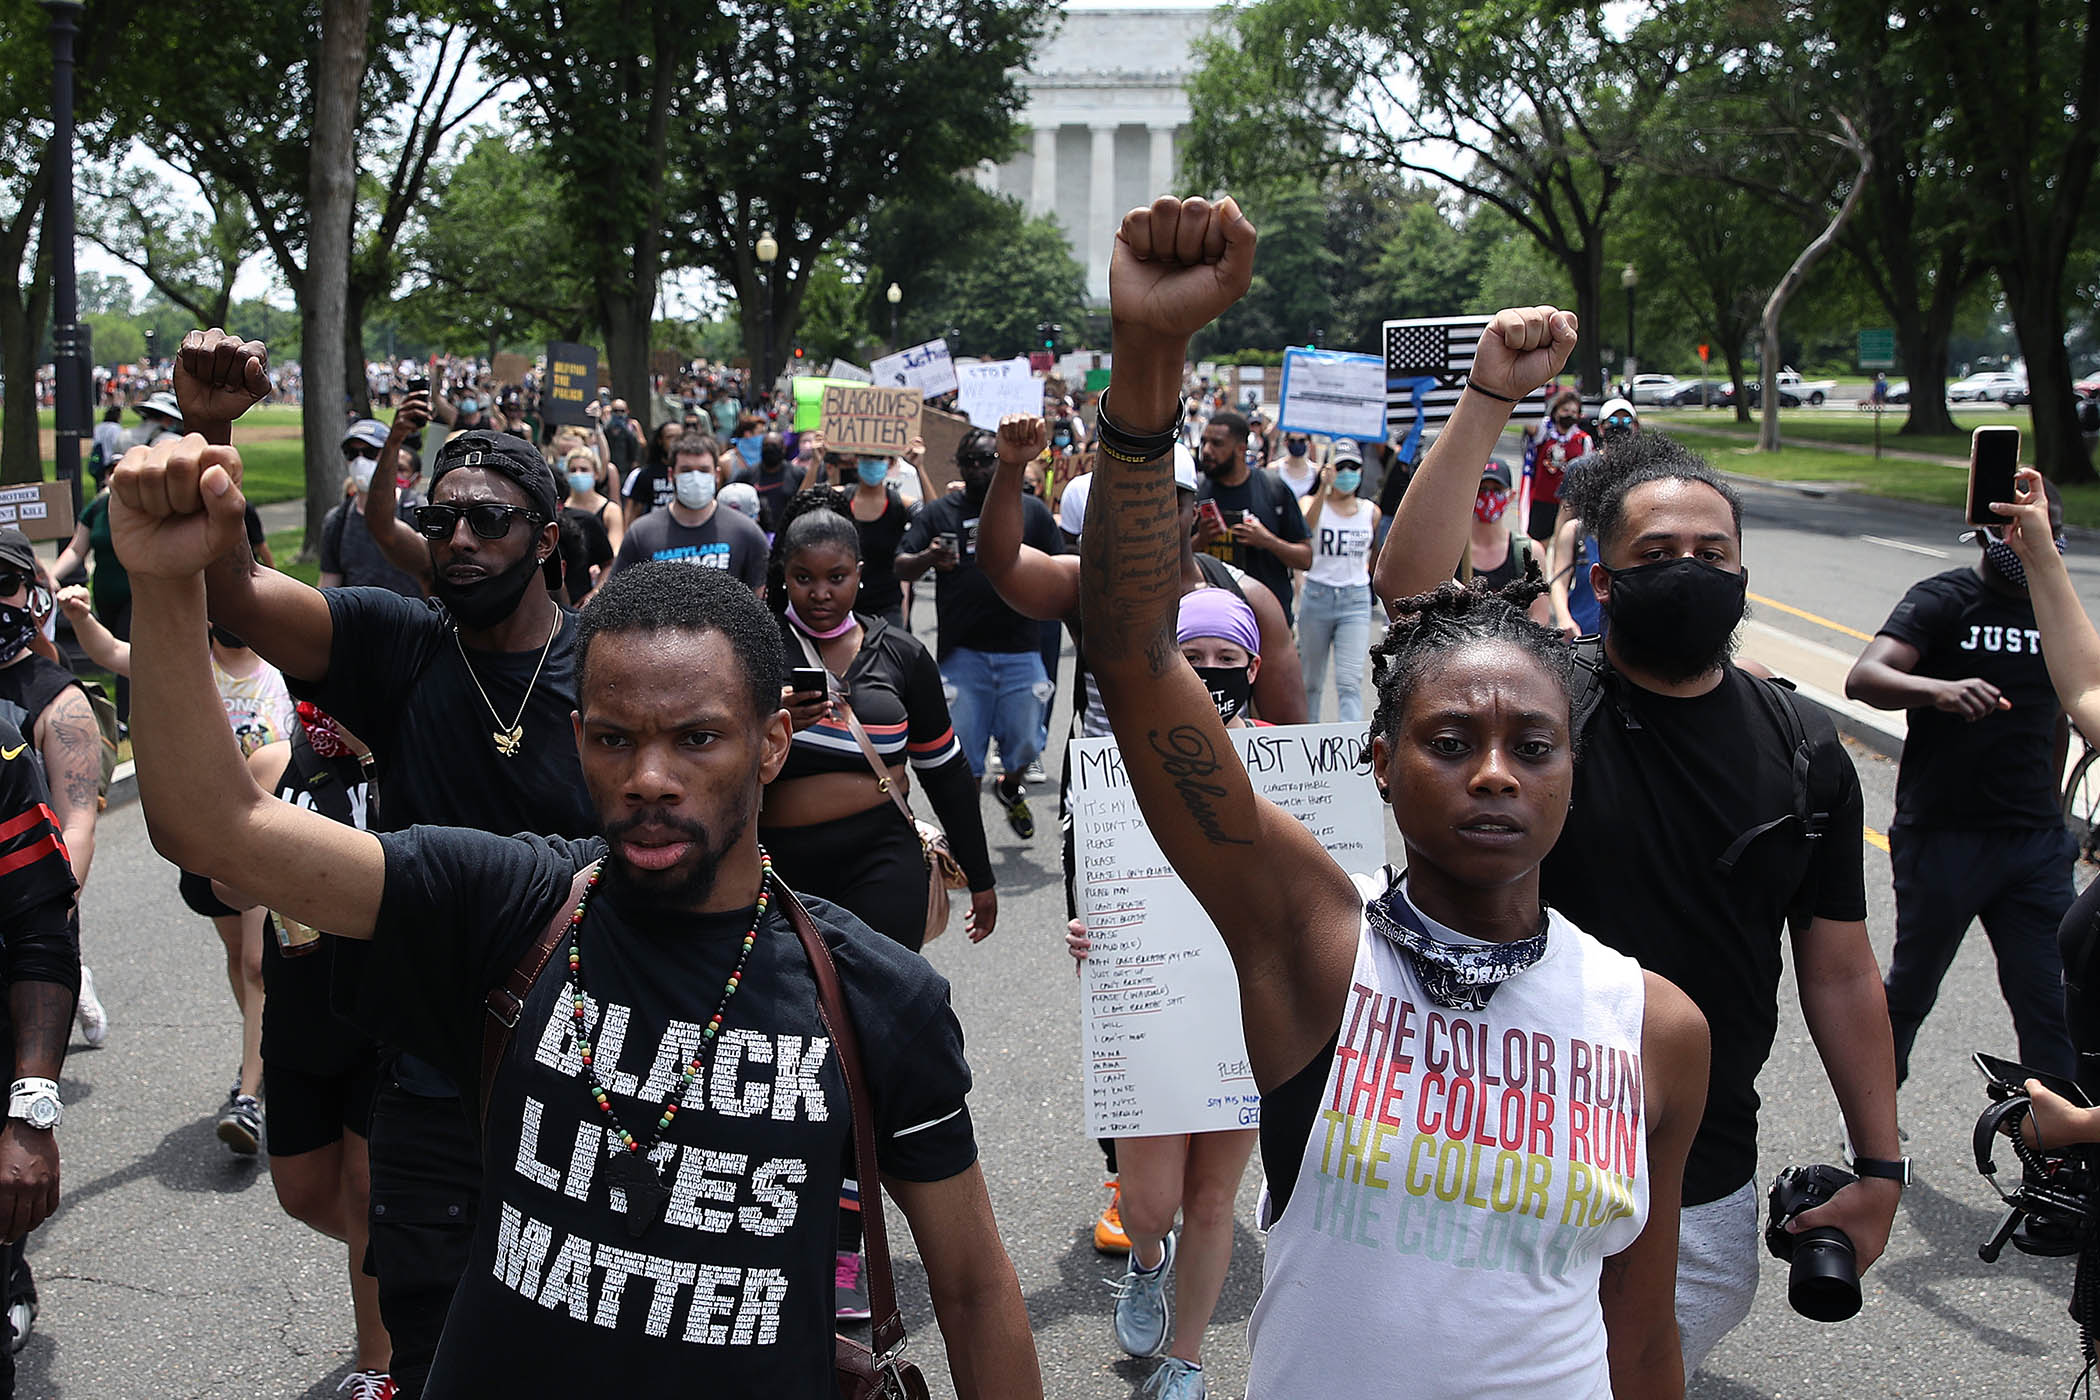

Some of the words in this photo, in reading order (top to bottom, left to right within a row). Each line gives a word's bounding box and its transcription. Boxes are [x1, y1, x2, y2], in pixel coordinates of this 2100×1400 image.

[825, 418, 908, 445] MATTER
[653, 543, 730, 561] MARYLAND
[1960, 626, 2040, 654] JUST
[1214, 699, 1235, 714] HE
[1080, 747, 1129, 790] MR.
[1247, 737, 1293, 773] AST
[1085, 856, 1116, 868] PLEASE
[1086, 839, 1115, 850] PLEASE
[1088, 930, 1118, 939] PLEASE
[535, 981, 830, 1122] BLACK
[1344, 983, 1415, 1066] THE
[1425, 1012, 1556, 1095] COLOR
[1570, 1040, 1640, 1114] RUN
[1332, 1046, 1412, 1127] THE
[1418, 1072, 1554, 1157] COLOR
[1569, 1101, 1638, 1178] RUN
[1320, 1109, 1399, 1189] THE
[1406, 1134, 1554, 1218] COLOR
[1314, 1172, 1381, 1248] THE
[1396, 1197, 1540, 1273] COLOR
[493, 1200, 788, 1345] MATTER
